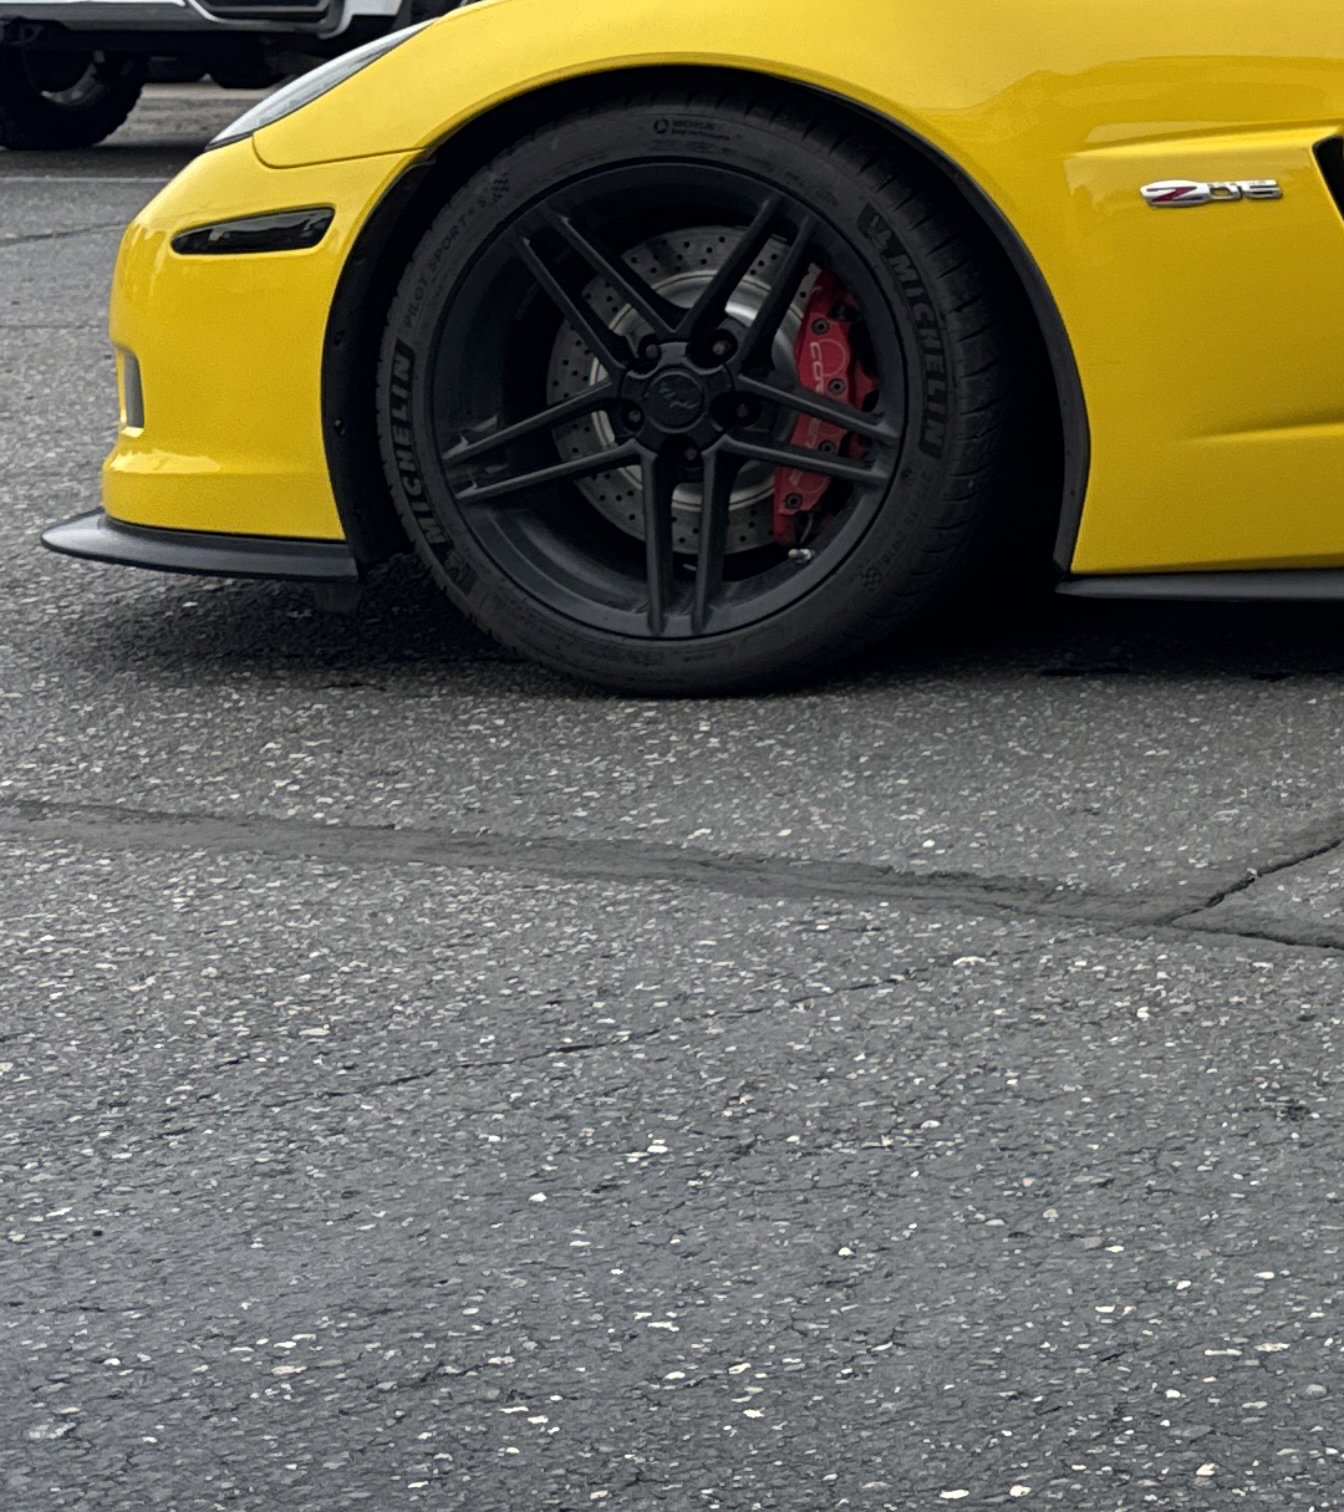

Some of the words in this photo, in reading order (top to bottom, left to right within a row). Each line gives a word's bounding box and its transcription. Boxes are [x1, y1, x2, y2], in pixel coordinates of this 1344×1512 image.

[1140, 179, 1282, 208] Z06
[403, 276, 429, 328] PILOT
[889, 257, 946, 444] MICHELIN
[391, 350, 448, 544] MICHELIN
